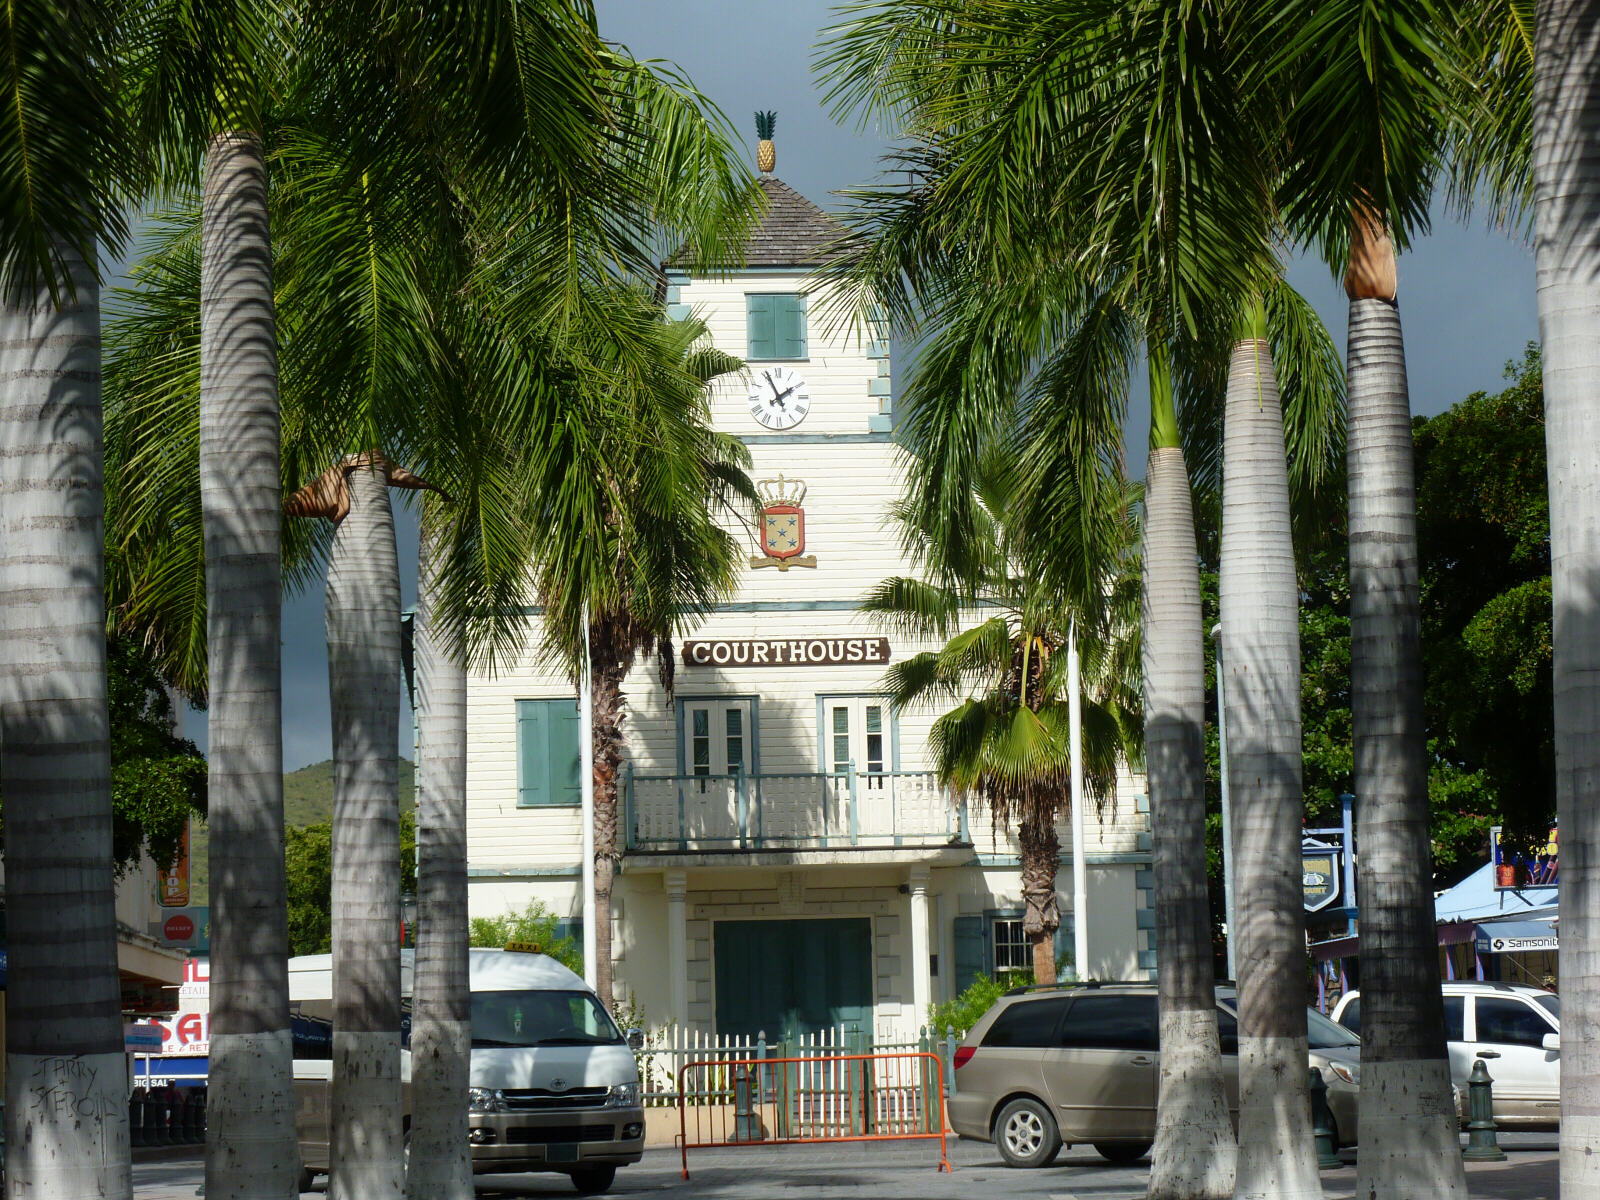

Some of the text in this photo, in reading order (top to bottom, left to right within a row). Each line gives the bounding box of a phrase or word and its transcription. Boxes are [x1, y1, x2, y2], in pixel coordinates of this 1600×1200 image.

[692, 639, 881, 664] COURTHOUSE
[512, 943, 537, 951] TAXI
[179, 986, 208, 995] ETAIL
[151, 1079, 176, 1087] SAL
